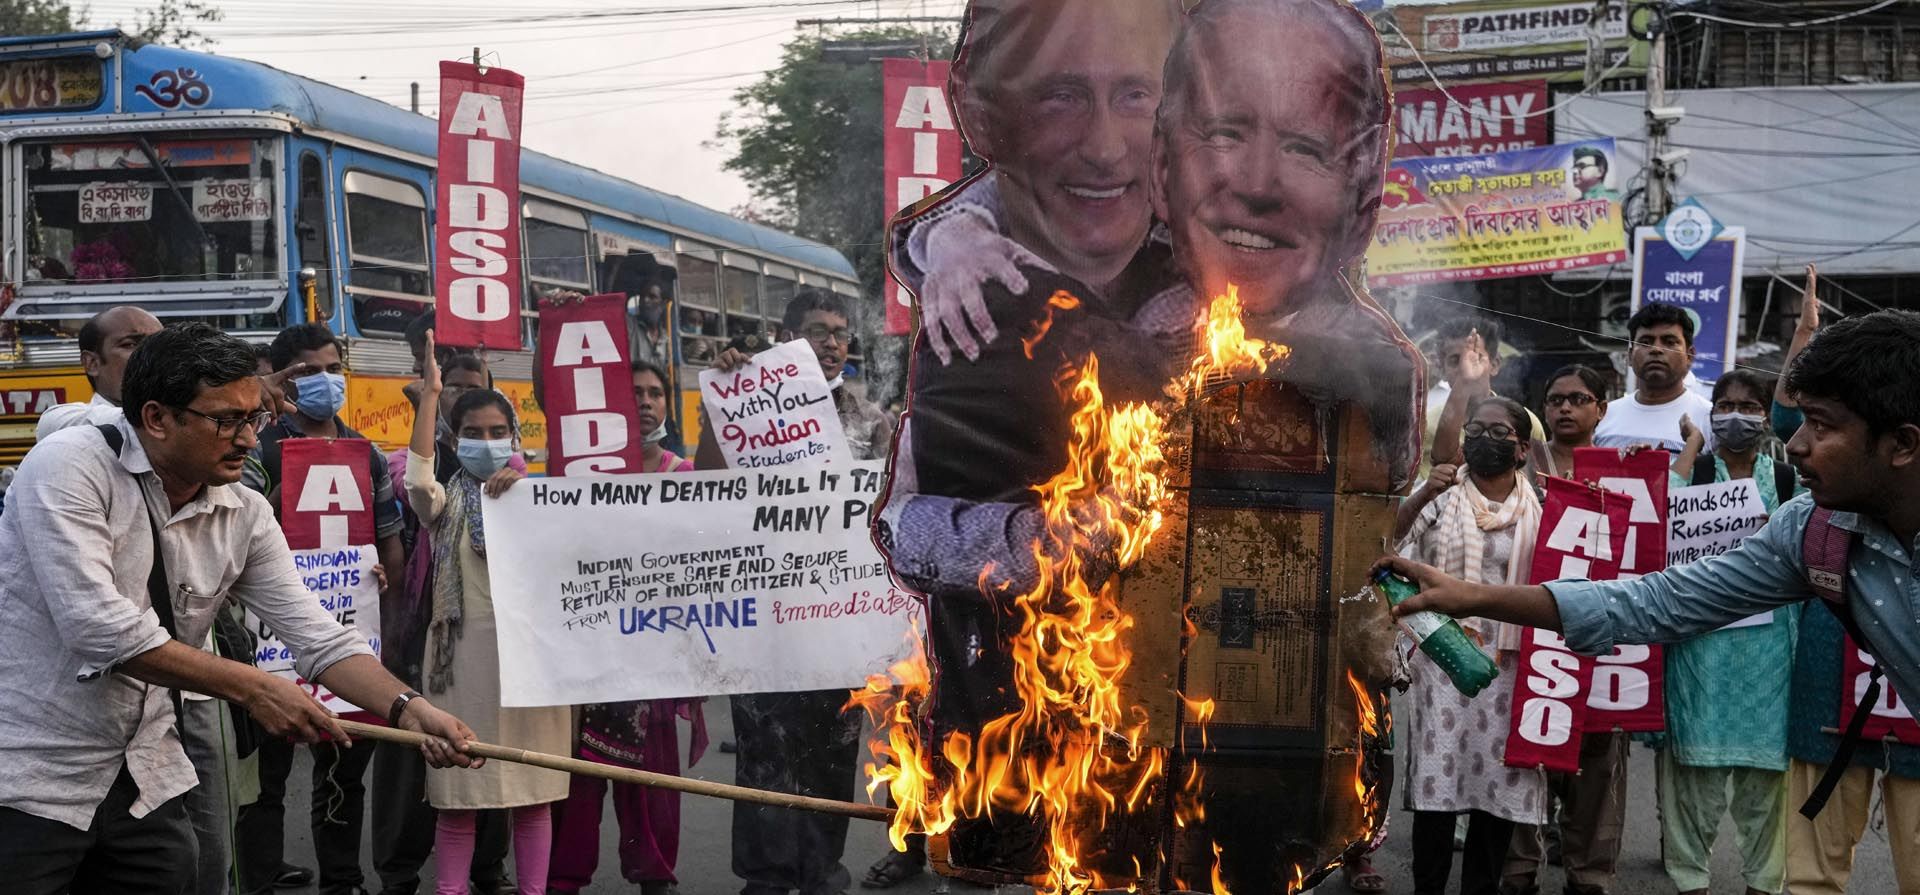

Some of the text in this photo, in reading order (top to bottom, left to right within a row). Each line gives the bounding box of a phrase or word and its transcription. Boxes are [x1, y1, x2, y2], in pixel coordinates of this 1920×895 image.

[1462, 5, 1622, 34] PATHFINDR
[1393, 93, 1535, 148] MANY
[447, 91, 512, 321] AIDSO
[1375, 216, 1460, 246] দেশপ্রেম
[1464, 204, 1538, 237] দিবসের
[1664, 270, 1703, 286] বাংলা
[710, 363, 799, 400] We Are
[0, 391, 57, 414] TA
[590, 482, 653, 506] MANY
[660, 476, 748, 503] DEATHS
[819, 470, 841, 492] IT
[1667, 490, 1717, 518] Hands
[752, 505, 831, 534] MANY
[1671, 515, 1757, 541] Russian
[577, 544, 765, 580] INDIAN GOVERNMENT
[684, 563, 731, 584] SAFE
[736, 557, 776, 579] AND
[781, 549, 848, 579] SECURE
[561, 588, 627, 615] RETURN
[636, 588, 659, 604] OF
[666, 580, 724, 602] INDIAN
[731, 571, 804, 594] CITIZEN
[619, 597, 757, 654] UKRAINE
